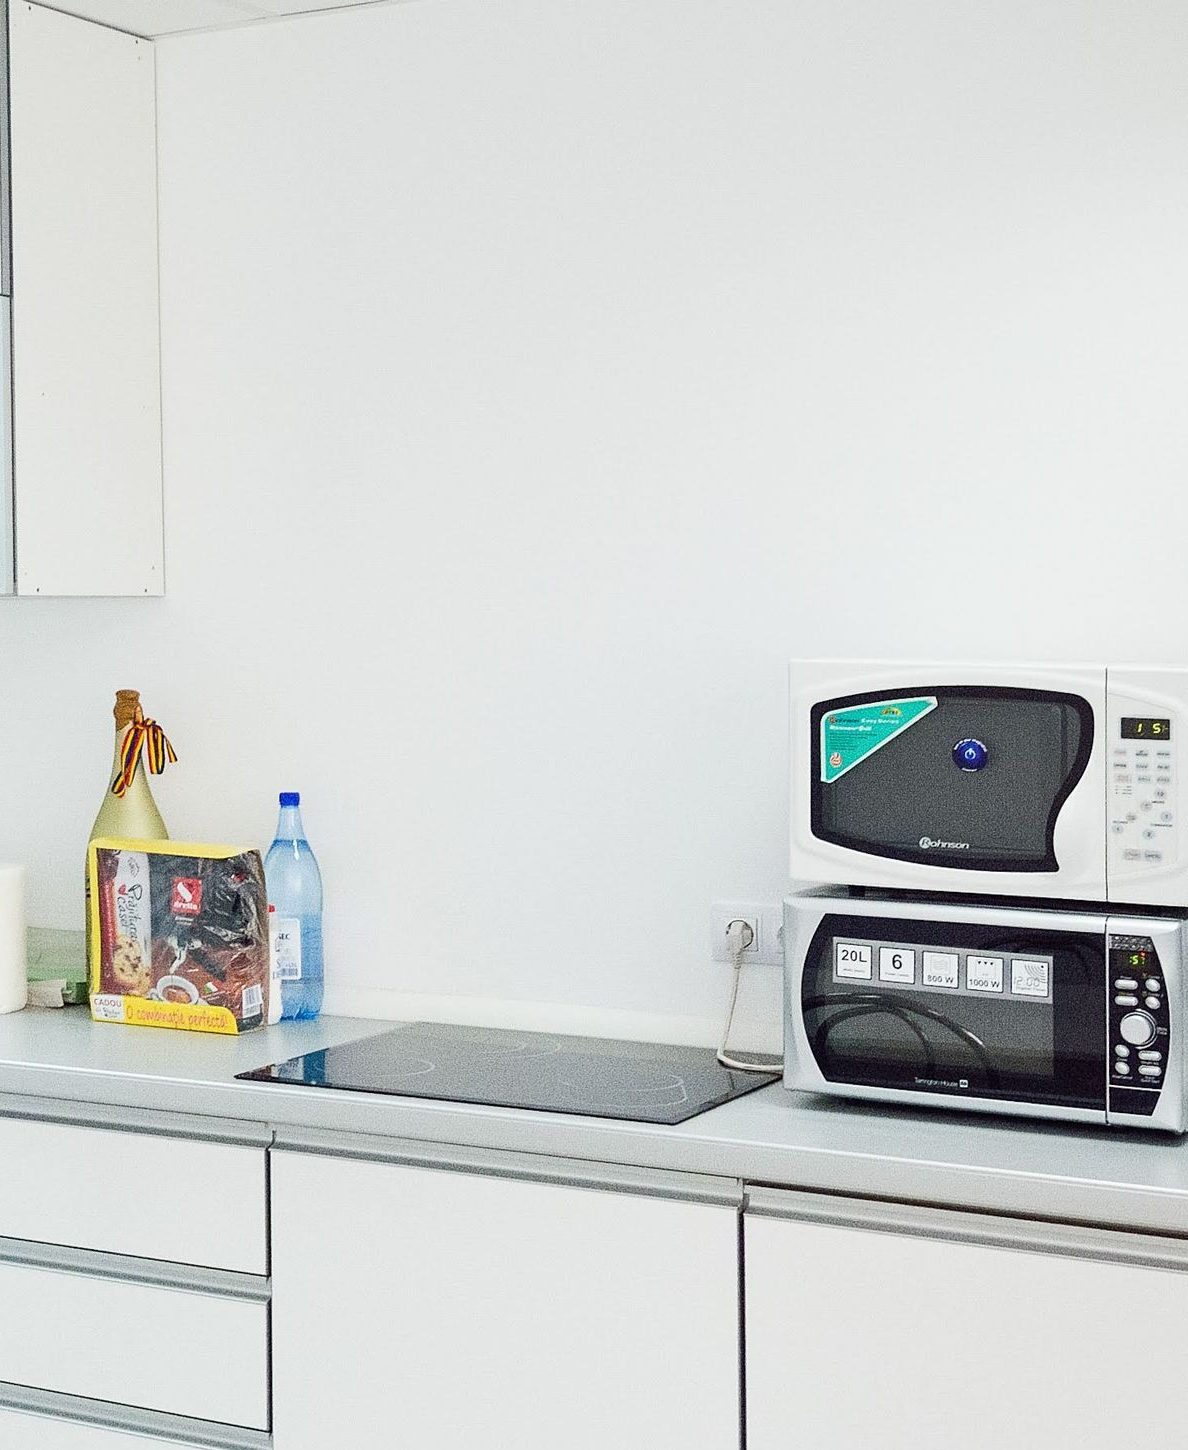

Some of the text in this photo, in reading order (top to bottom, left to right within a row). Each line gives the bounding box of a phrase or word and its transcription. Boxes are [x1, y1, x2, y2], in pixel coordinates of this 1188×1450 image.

[841, 949, 868, 963] 20L
[892, 954, 903, 970] 6
[945, 976, 955, 984] W
[969, 978, 1000, 988] 1000 W
